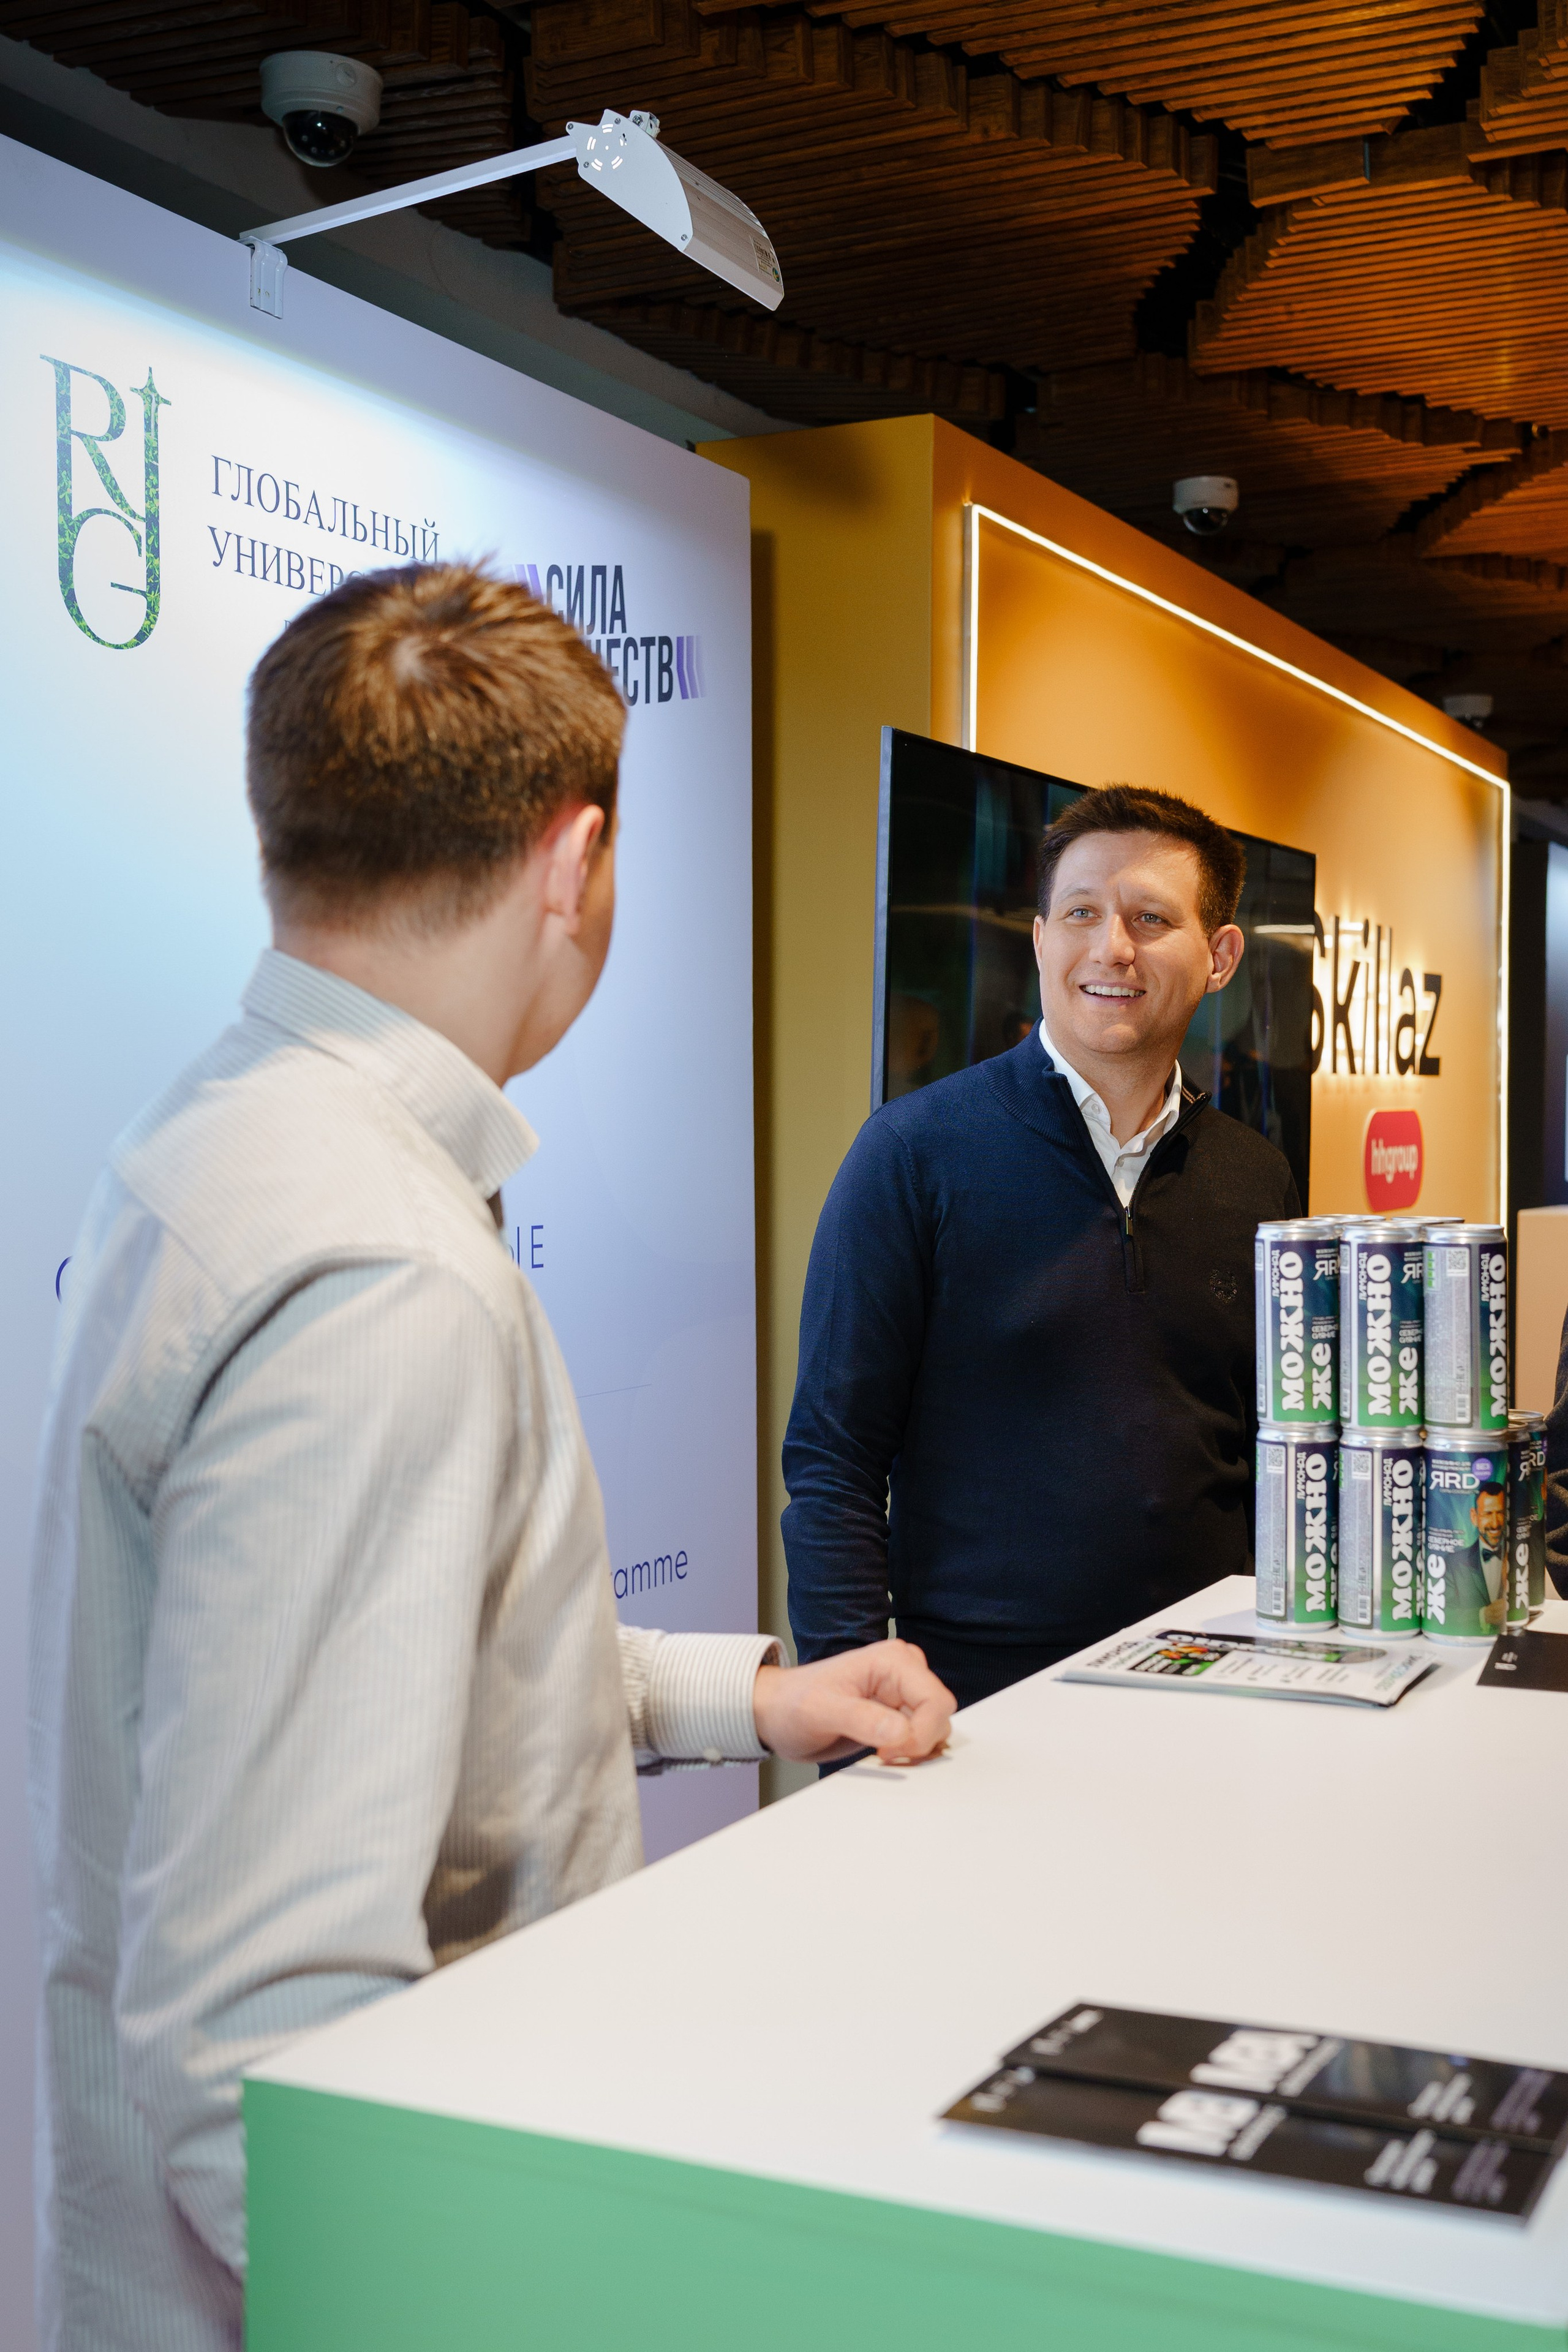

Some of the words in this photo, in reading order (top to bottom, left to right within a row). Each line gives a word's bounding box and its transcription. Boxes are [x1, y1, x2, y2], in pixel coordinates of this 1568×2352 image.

[211, 454, 440, 564] ГЛОБАЛЬНЫЙ
[546, 564, 627, 635] СИЛА
[1371, 1137, 1419, 1184] hhgroup
[1311, 1342, 1332, 1410] же
[1398, 1346, 1418, 1415] же
[611, 1550, 688, 1599] amme
[1427, 1553, 1446, 1625] же
